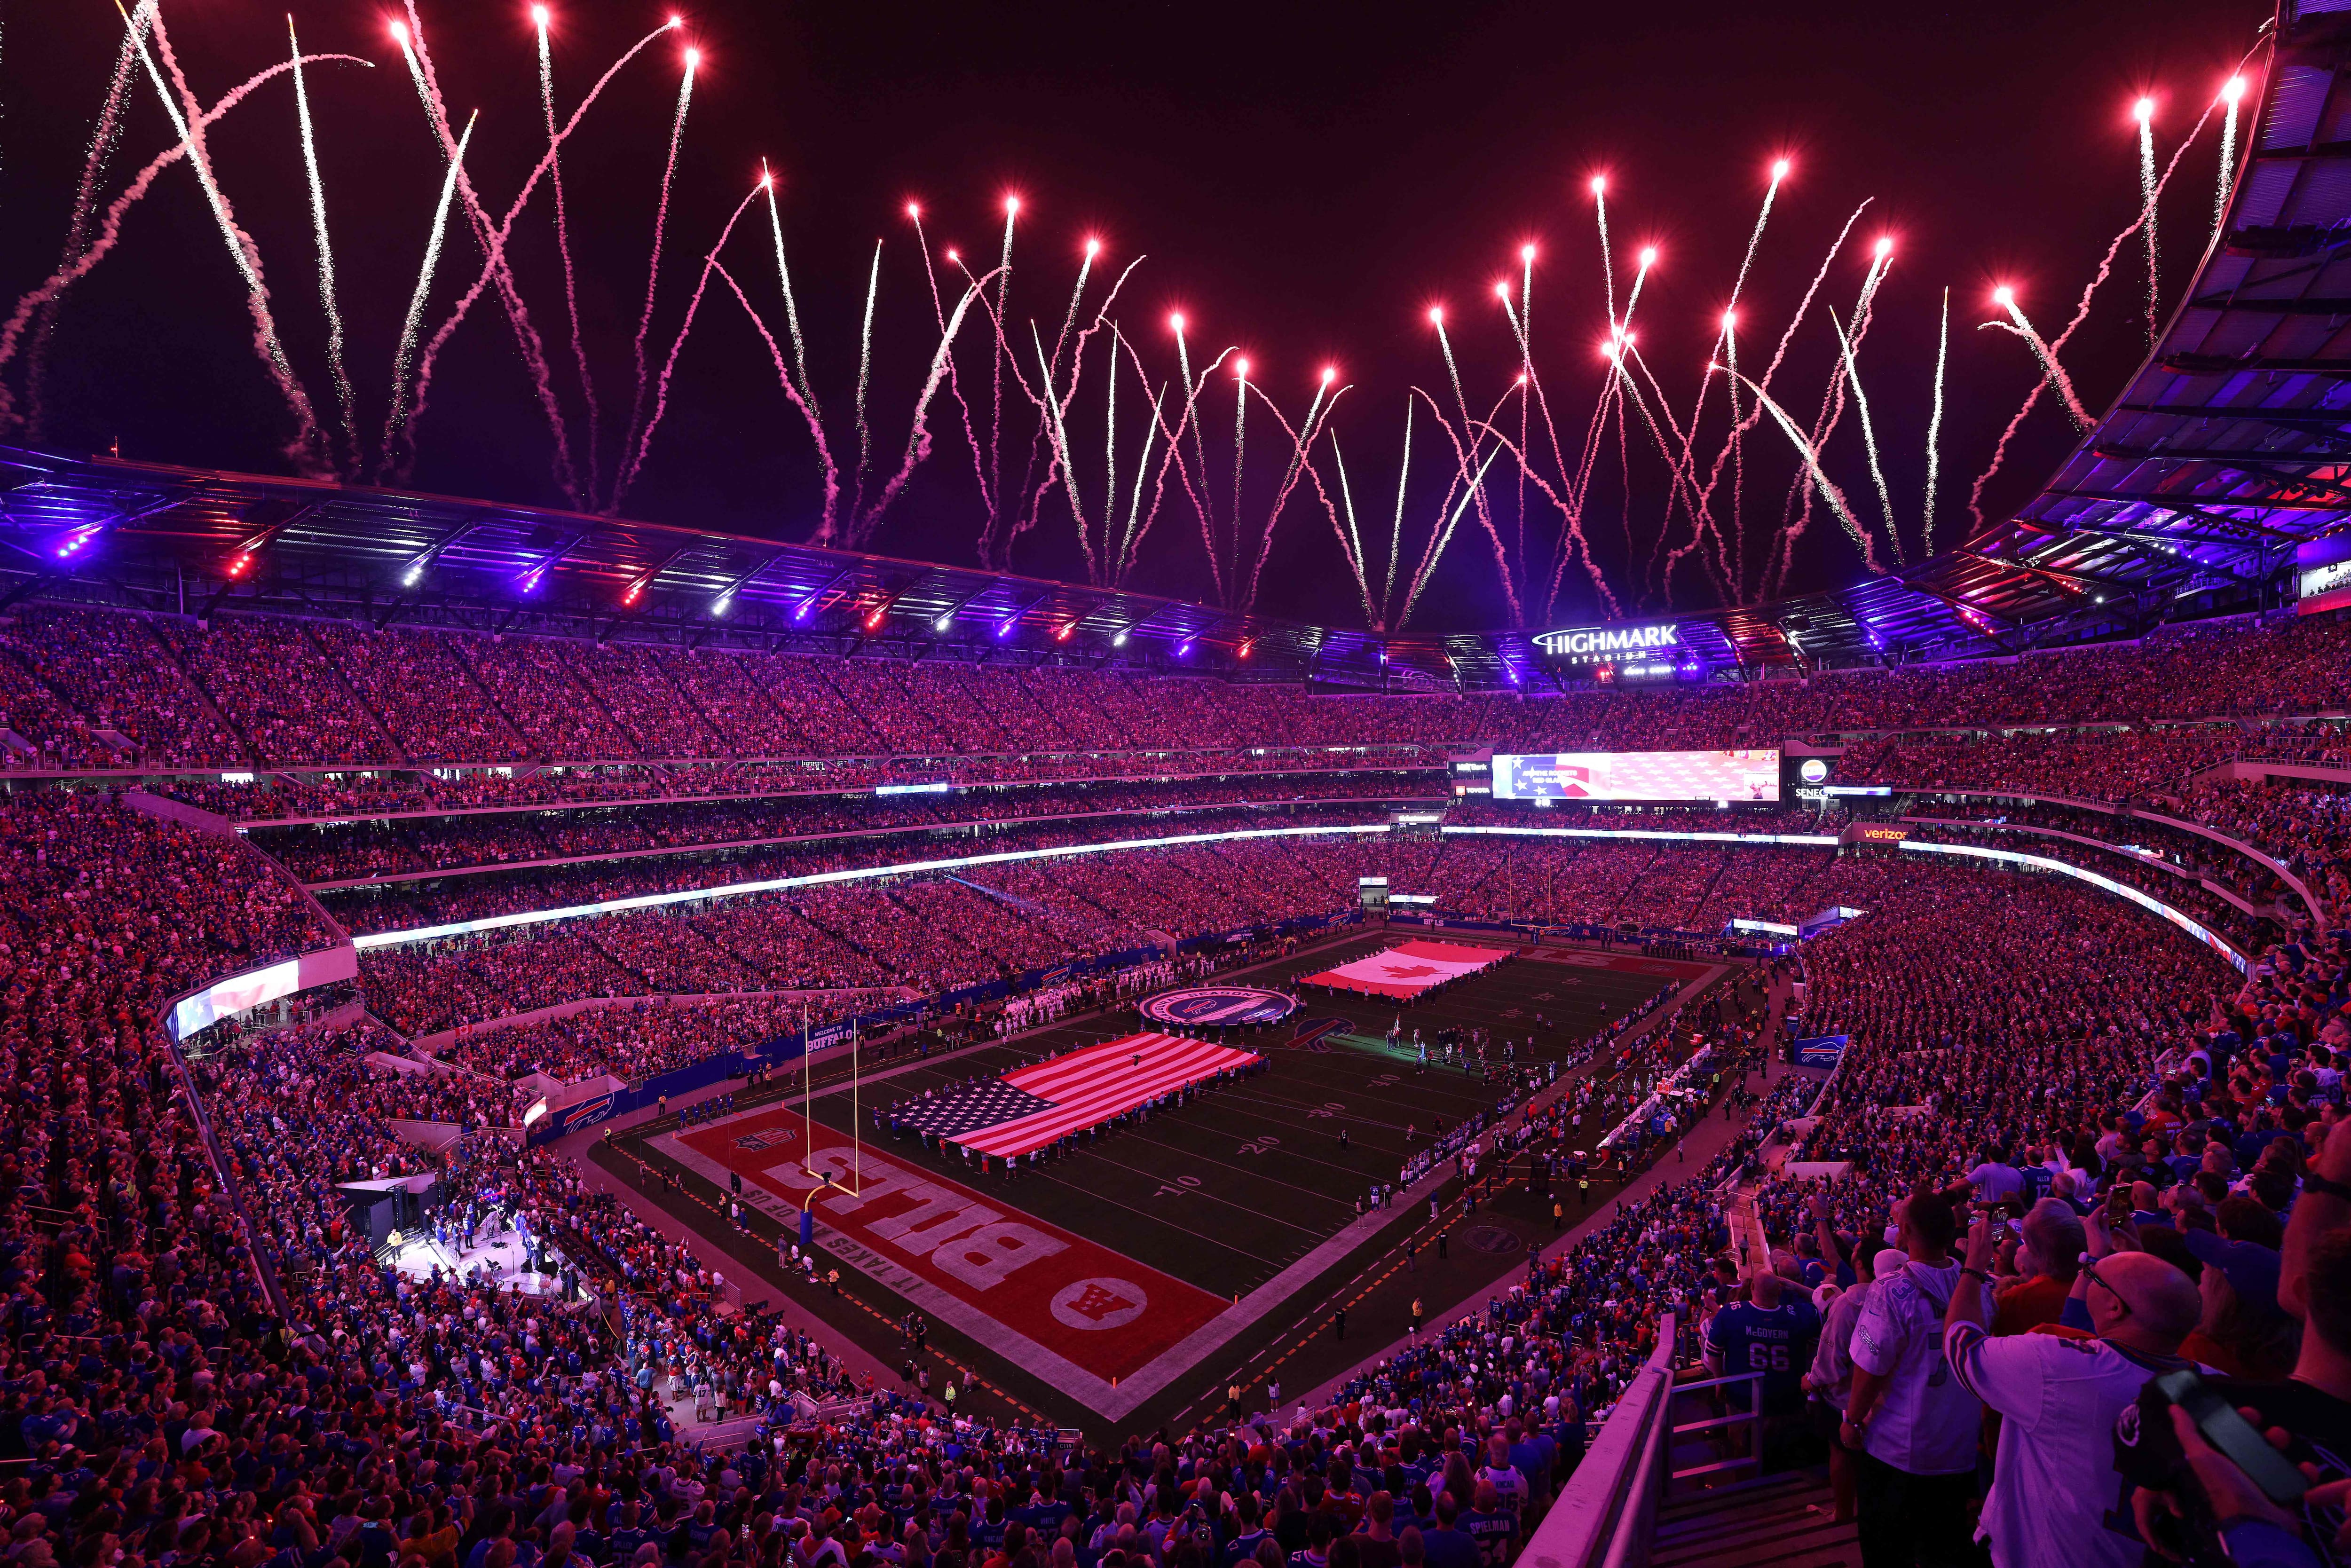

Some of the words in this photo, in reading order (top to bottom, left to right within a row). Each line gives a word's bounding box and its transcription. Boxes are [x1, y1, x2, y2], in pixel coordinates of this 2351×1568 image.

[1546, 625, 1678, 654] HIGHMARK
[1571, 651, 1647, 664] STADIUM
[1237, 1008, 1276, 1021] 2026
[815, 1027, 836, 1037] WELCOME
[807, 1029, 852, 1052] BUFFALO
[1241, 1136, 1280, 1155] 20
[1160, 1176, 1202, 1197] 10
[2035, 1185, 2051, 1198] 17
[742, 1189, 775, 1206] US
[764, 1203, 792, 1218] OF
[761, 1147, 1072, 1292] BILLS
[825, 1238, 895, 1278] TAKES
[889, 1273, 926, 1294] IT
[1745, 1324, 1789, 1339] McGOVERN
[1749, 1342, 1791, 1372] 66
[1433, 1458, 1442, 1466] 17
[1352, 1495, 1360, 1505] 17
[1040, 1516, 1056, 1525] WHITE
[1470, 1520, 1510, 1535] SPIELMAN
[613, 1541, 632, 1550] SPILLER
[1227, 1540, 1239, 1552] 17
